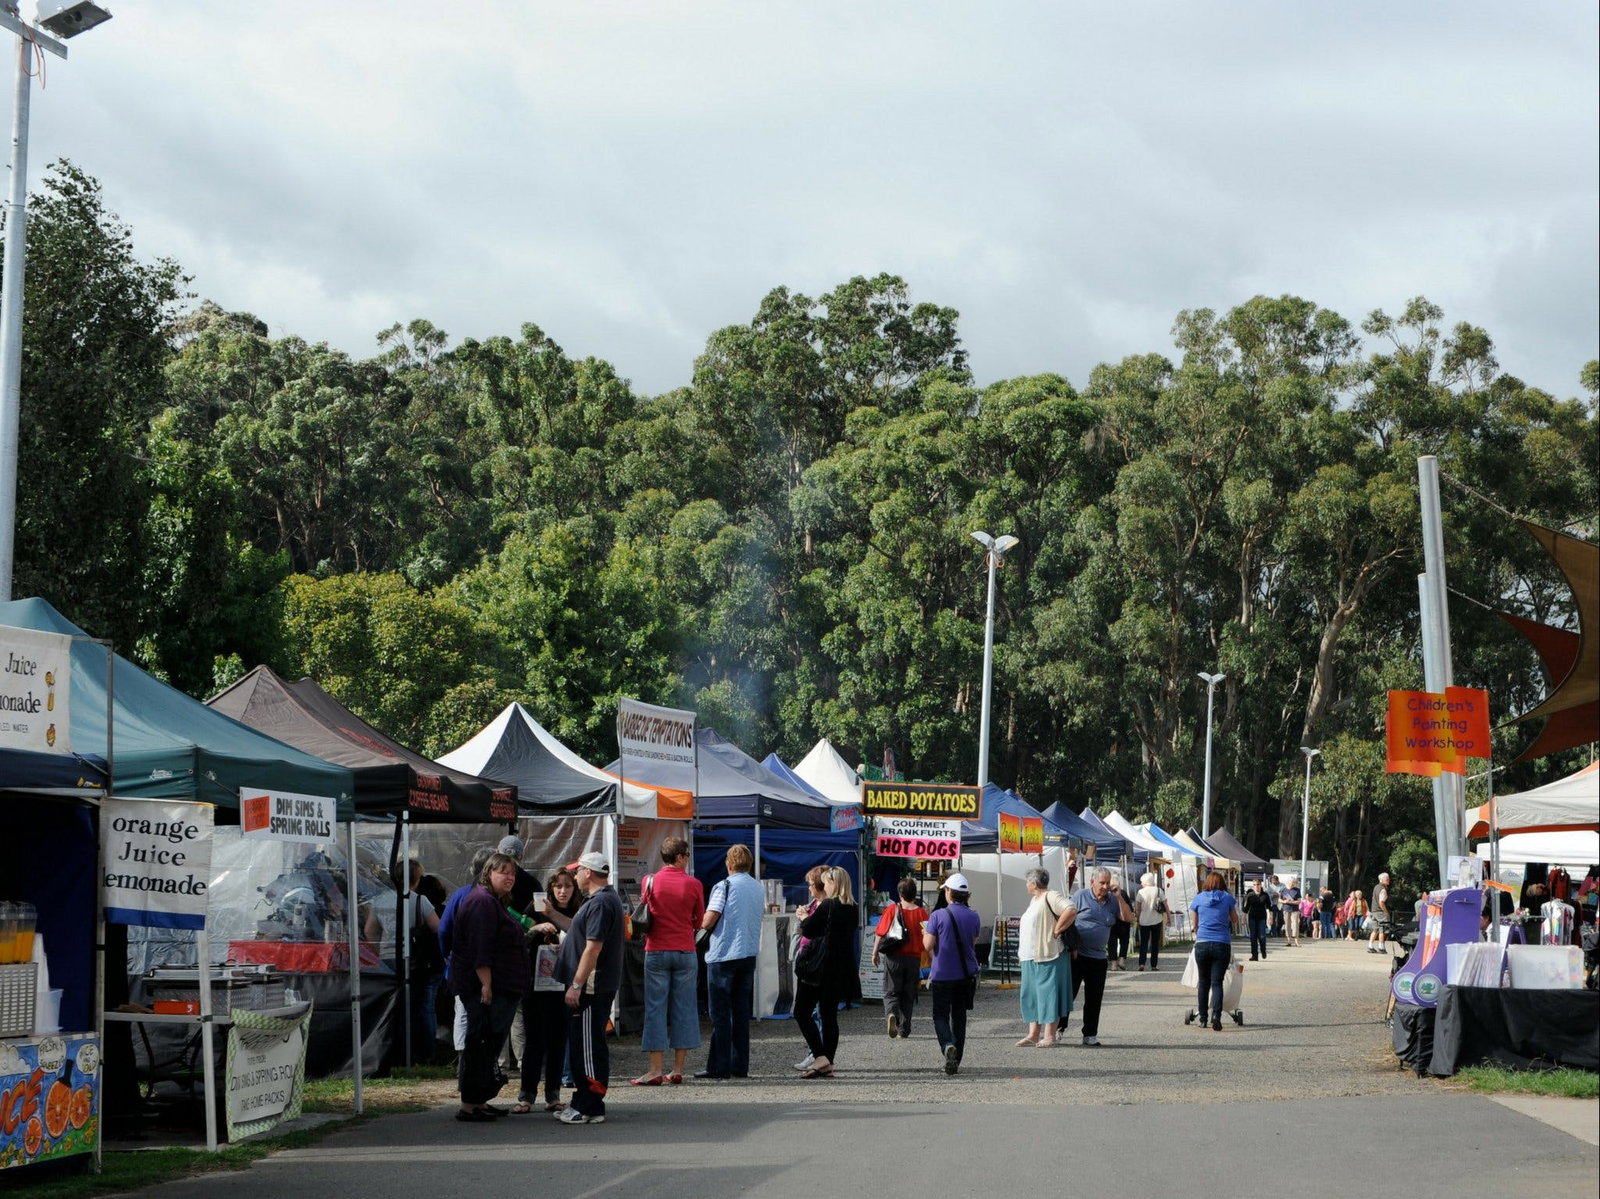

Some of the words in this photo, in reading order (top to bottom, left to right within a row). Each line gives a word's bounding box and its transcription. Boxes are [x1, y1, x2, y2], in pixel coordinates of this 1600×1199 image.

[5, 652, 37, 676] Juice
[1407, 698, 1475, 713] Children's
[1413, 717, 1468, 734] Painting
[1405, 736, 1475, 751] Workshop
[276, 798, 293, 816] DIM
[295, 800, 315, 818] SIMS
[316, 802, 324, 819] &
[867, 790, 907, 810] BAKED
[910, 792, 976, 813] POTATOES
[112, 817, 199, 844] orange
[270, 816, 303, 836] SPRING
[304, 819, 331, 838] ROLLS
[881, 828, 957, 838] FRANKFURTS
[892, 820, 948, 829] GOURMET
[118, 841, 187, 867] Juice
[879, 839, 912, 855] HOT
[915, 841, 958, 857] DOGS
[103, 867, 207, 896] lemonade
[264, 1090, 285, 1107] PACKS
